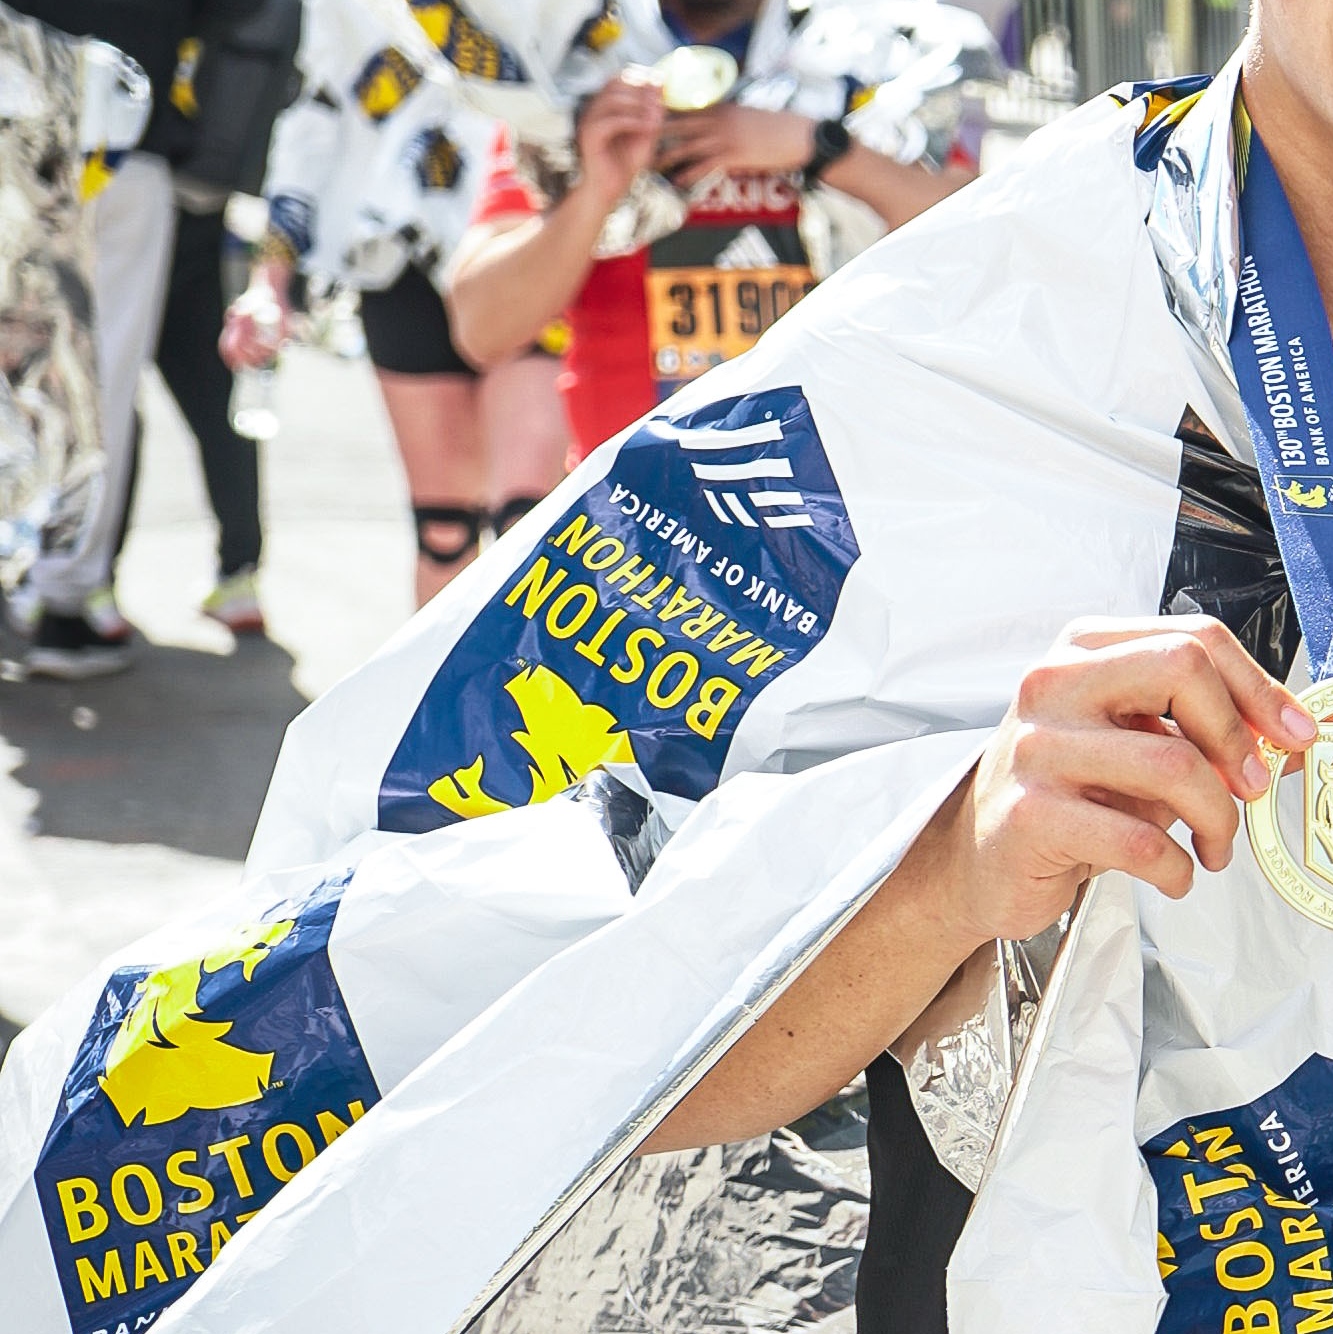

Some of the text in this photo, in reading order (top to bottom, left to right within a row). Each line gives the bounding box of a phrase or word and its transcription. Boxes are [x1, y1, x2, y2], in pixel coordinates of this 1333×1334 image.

[669, 281, 819, 336] 3190
[1258, 355, 1298, 429] BOSTON
[1288, 336, 1330, 466] BANK OF AMERICA
[552, 513, 785, 679] MARATHON
[608, 482, 818, 635] BANK OF AMERICA
[504, 555, 743, 741] BOSTON
[1264, 845, 1314, 904] BOSTON
[56, 1099, 367, 1244] BOSTON
[1259, 1109, 1320, 1208] ERICA
[75, 1210, 259, 1304] MARA
